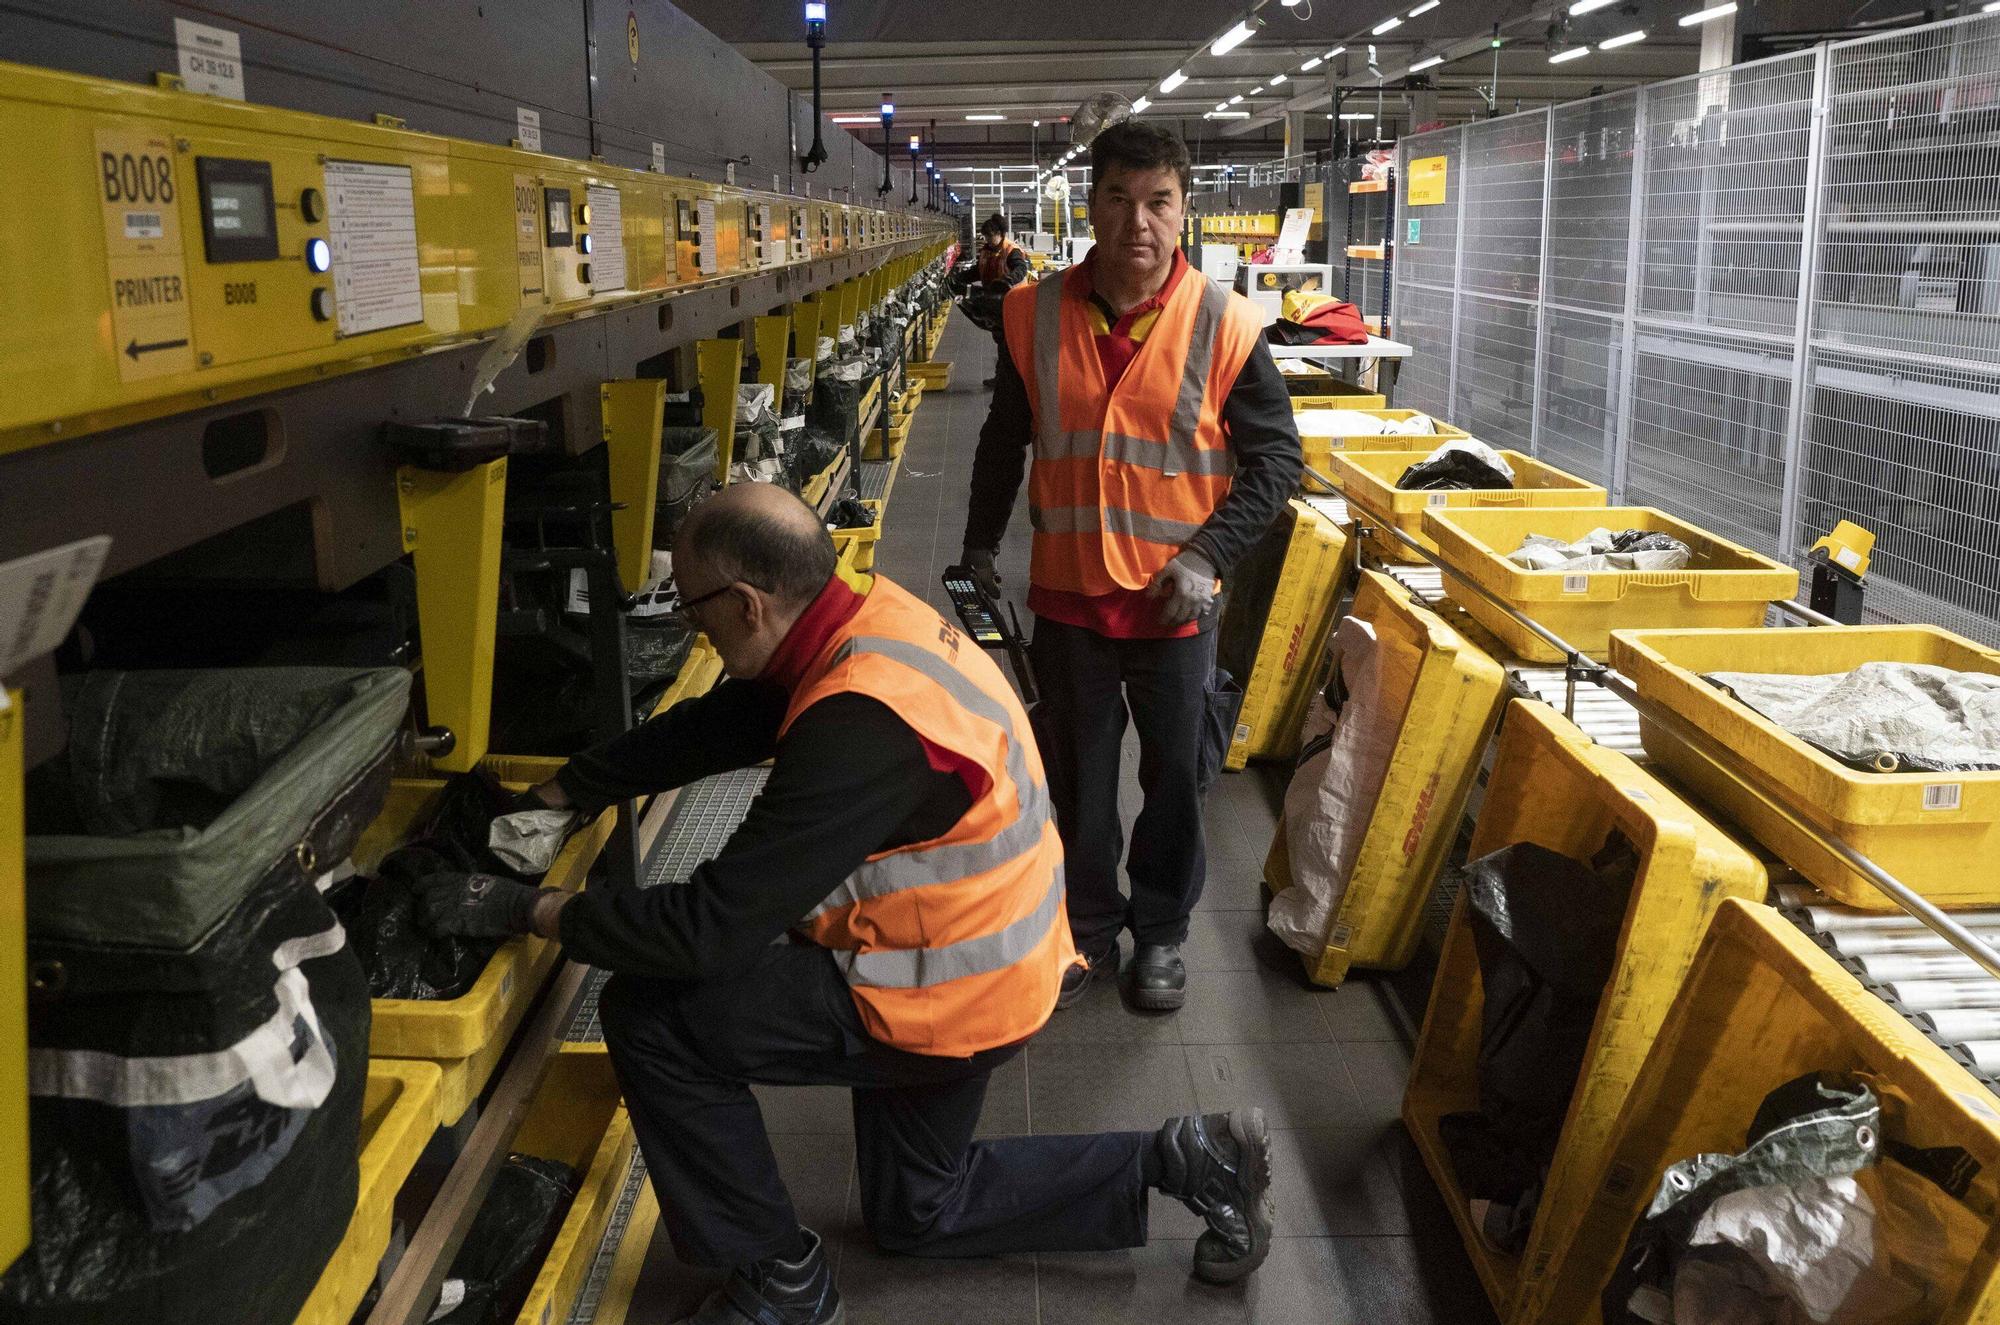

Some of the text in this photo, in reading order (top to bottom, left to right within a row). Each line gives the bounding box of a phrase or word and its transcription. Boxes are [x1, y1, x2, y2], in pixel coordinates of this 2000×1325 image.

[102, 152, 173, 203] B008
[115, 276, 183, 306] PRINTER
[1283, 621, 1307, 671] DHL
[1402, 787, 1438, 857] DHL
